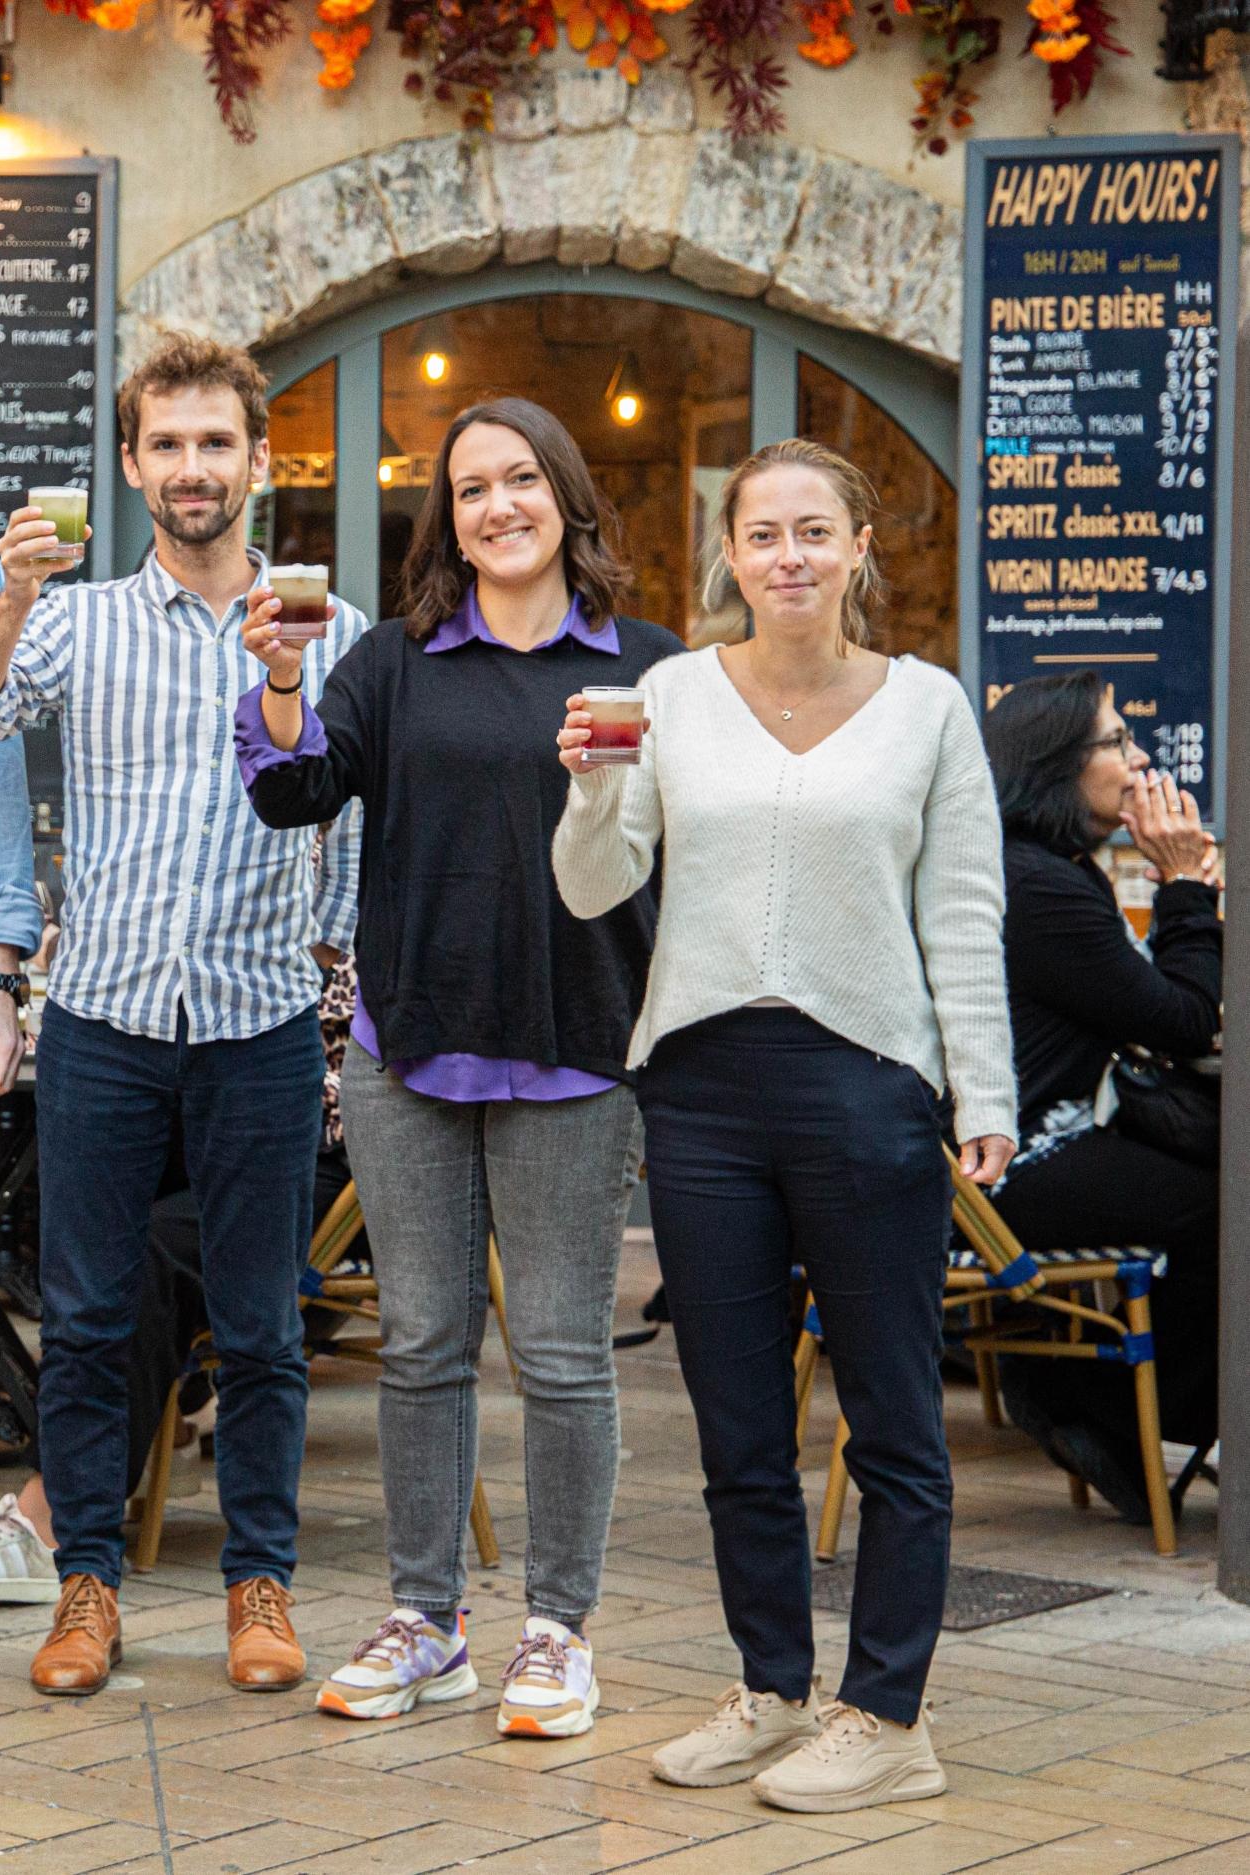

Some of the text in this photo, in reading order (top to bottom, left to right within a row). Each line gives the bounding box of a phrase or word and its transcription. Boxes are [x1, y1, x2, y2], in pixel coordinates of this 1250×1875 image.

[72, 191, 91, 214] 9
[987, 159, 1218, 227] HAPPY HOURS!
[67, 227, 91, 250] 17
[67, 263, 90, 284] 17
[67, 297, 89, 318] 17
[990, 295, 1057, 332] PINTE
[1061, 294, 1094, 330] DE
[1076, 369, 1141, 391] BLANCHE
[987, 454, 1058, 489] SPRITZ
[1064, 453, 1121, 487] classic
[987, 504, 1058, 539] SPRITZ
[1064, 503, 1120, 538] classic
[1122, 511, 1162, 537] XXL
[986, 558, 1053, 594] VIRGIN
[1058, 556, 1148, 592] PARADISE
